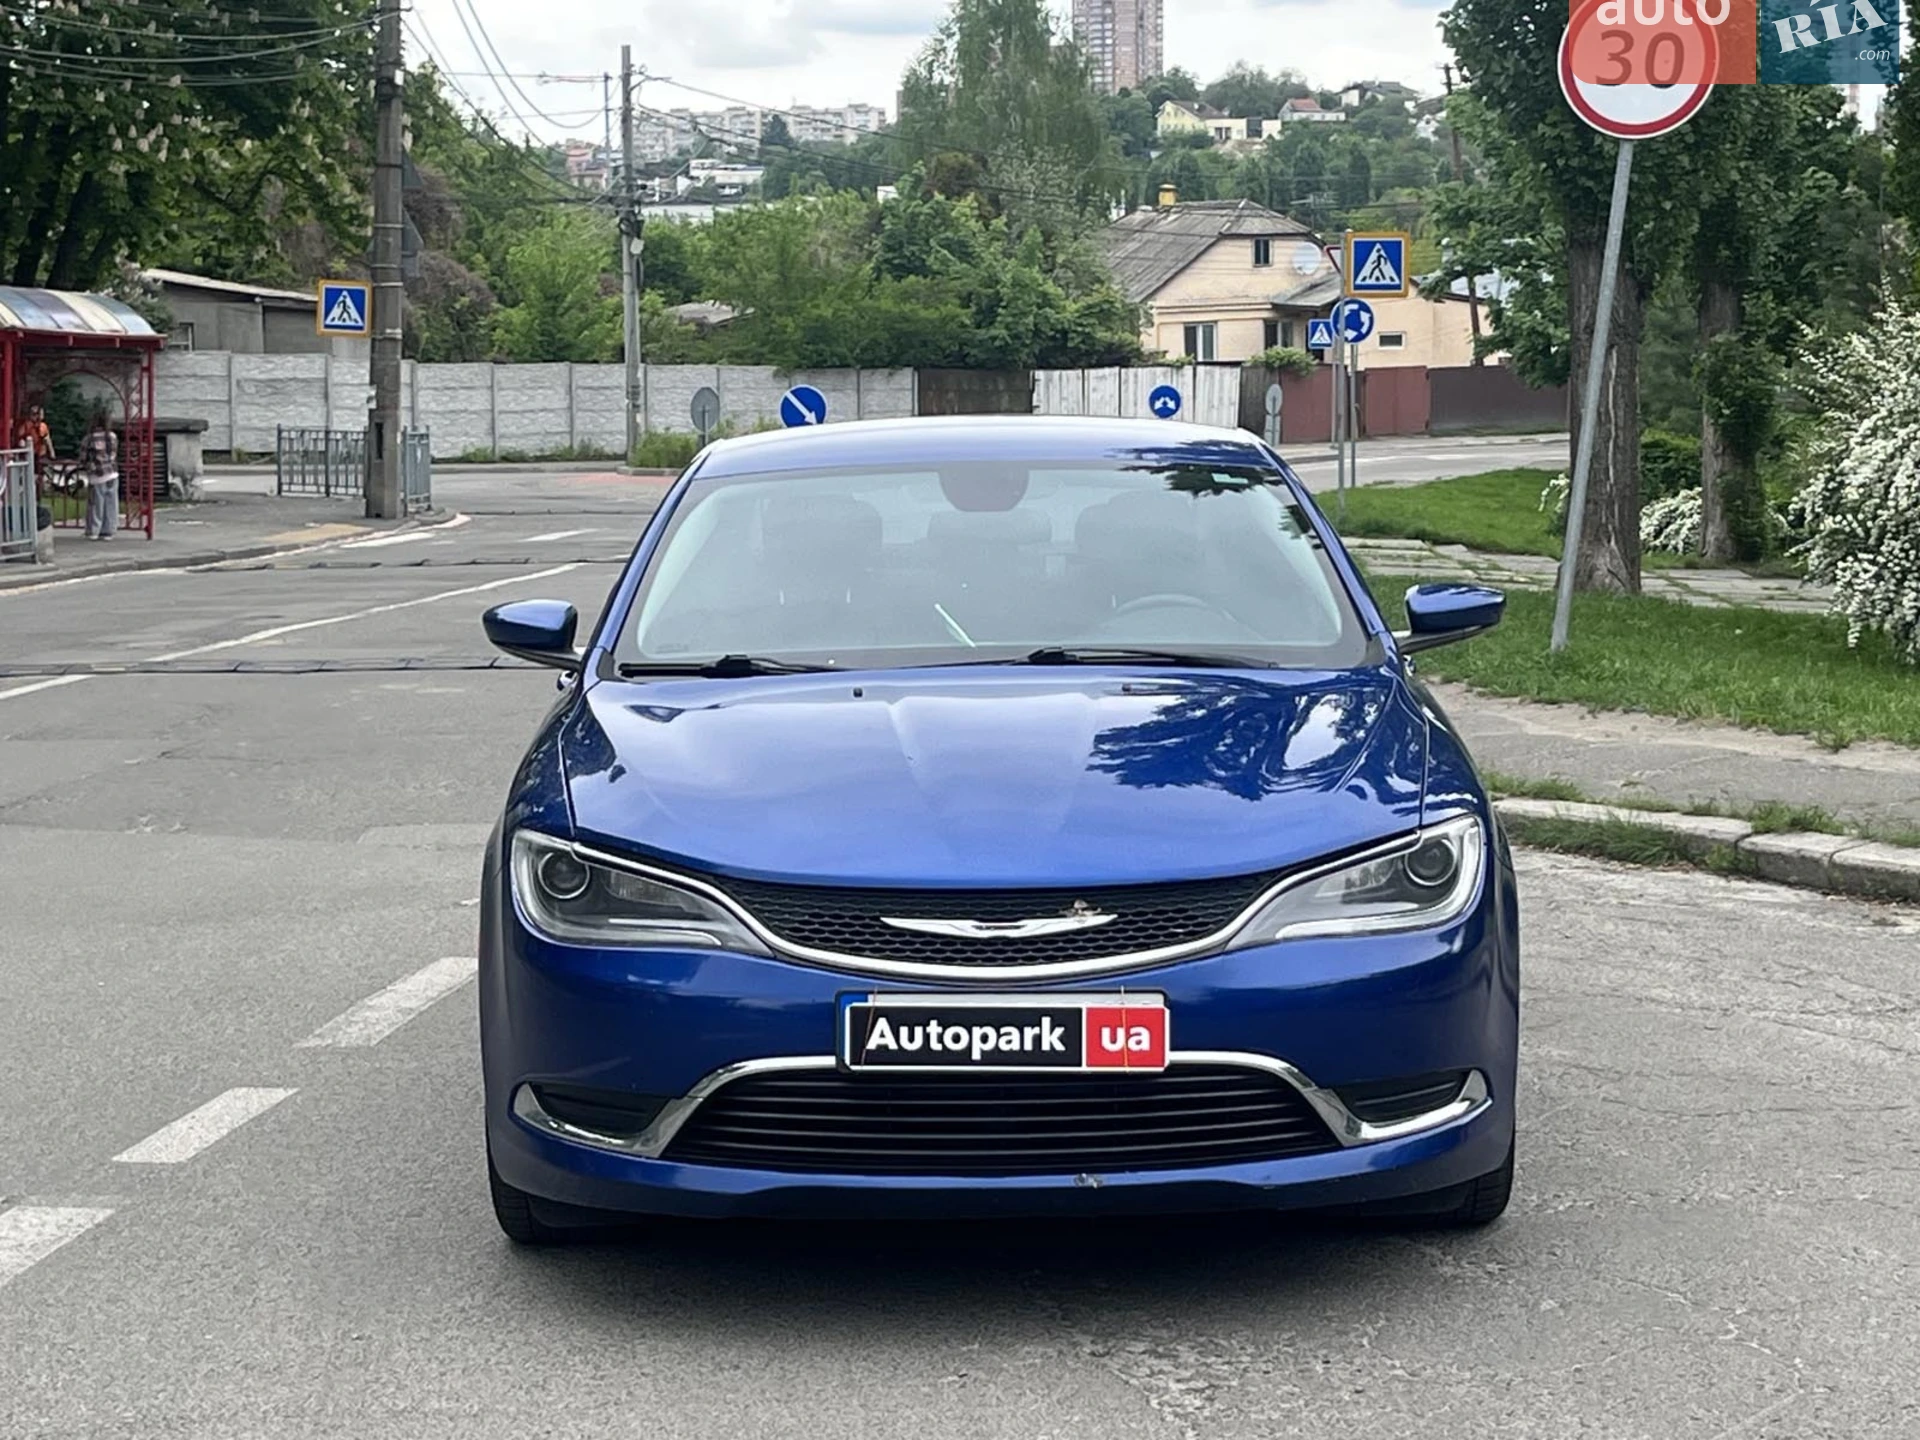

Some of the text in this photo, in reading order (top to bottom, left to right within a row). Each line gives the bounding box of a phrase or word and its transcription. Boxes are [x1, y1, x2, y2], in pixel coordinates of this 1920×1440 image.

[1595, 29, 1685, 89] 30
[866, 1016, 1151, 1061] Autopark ua
